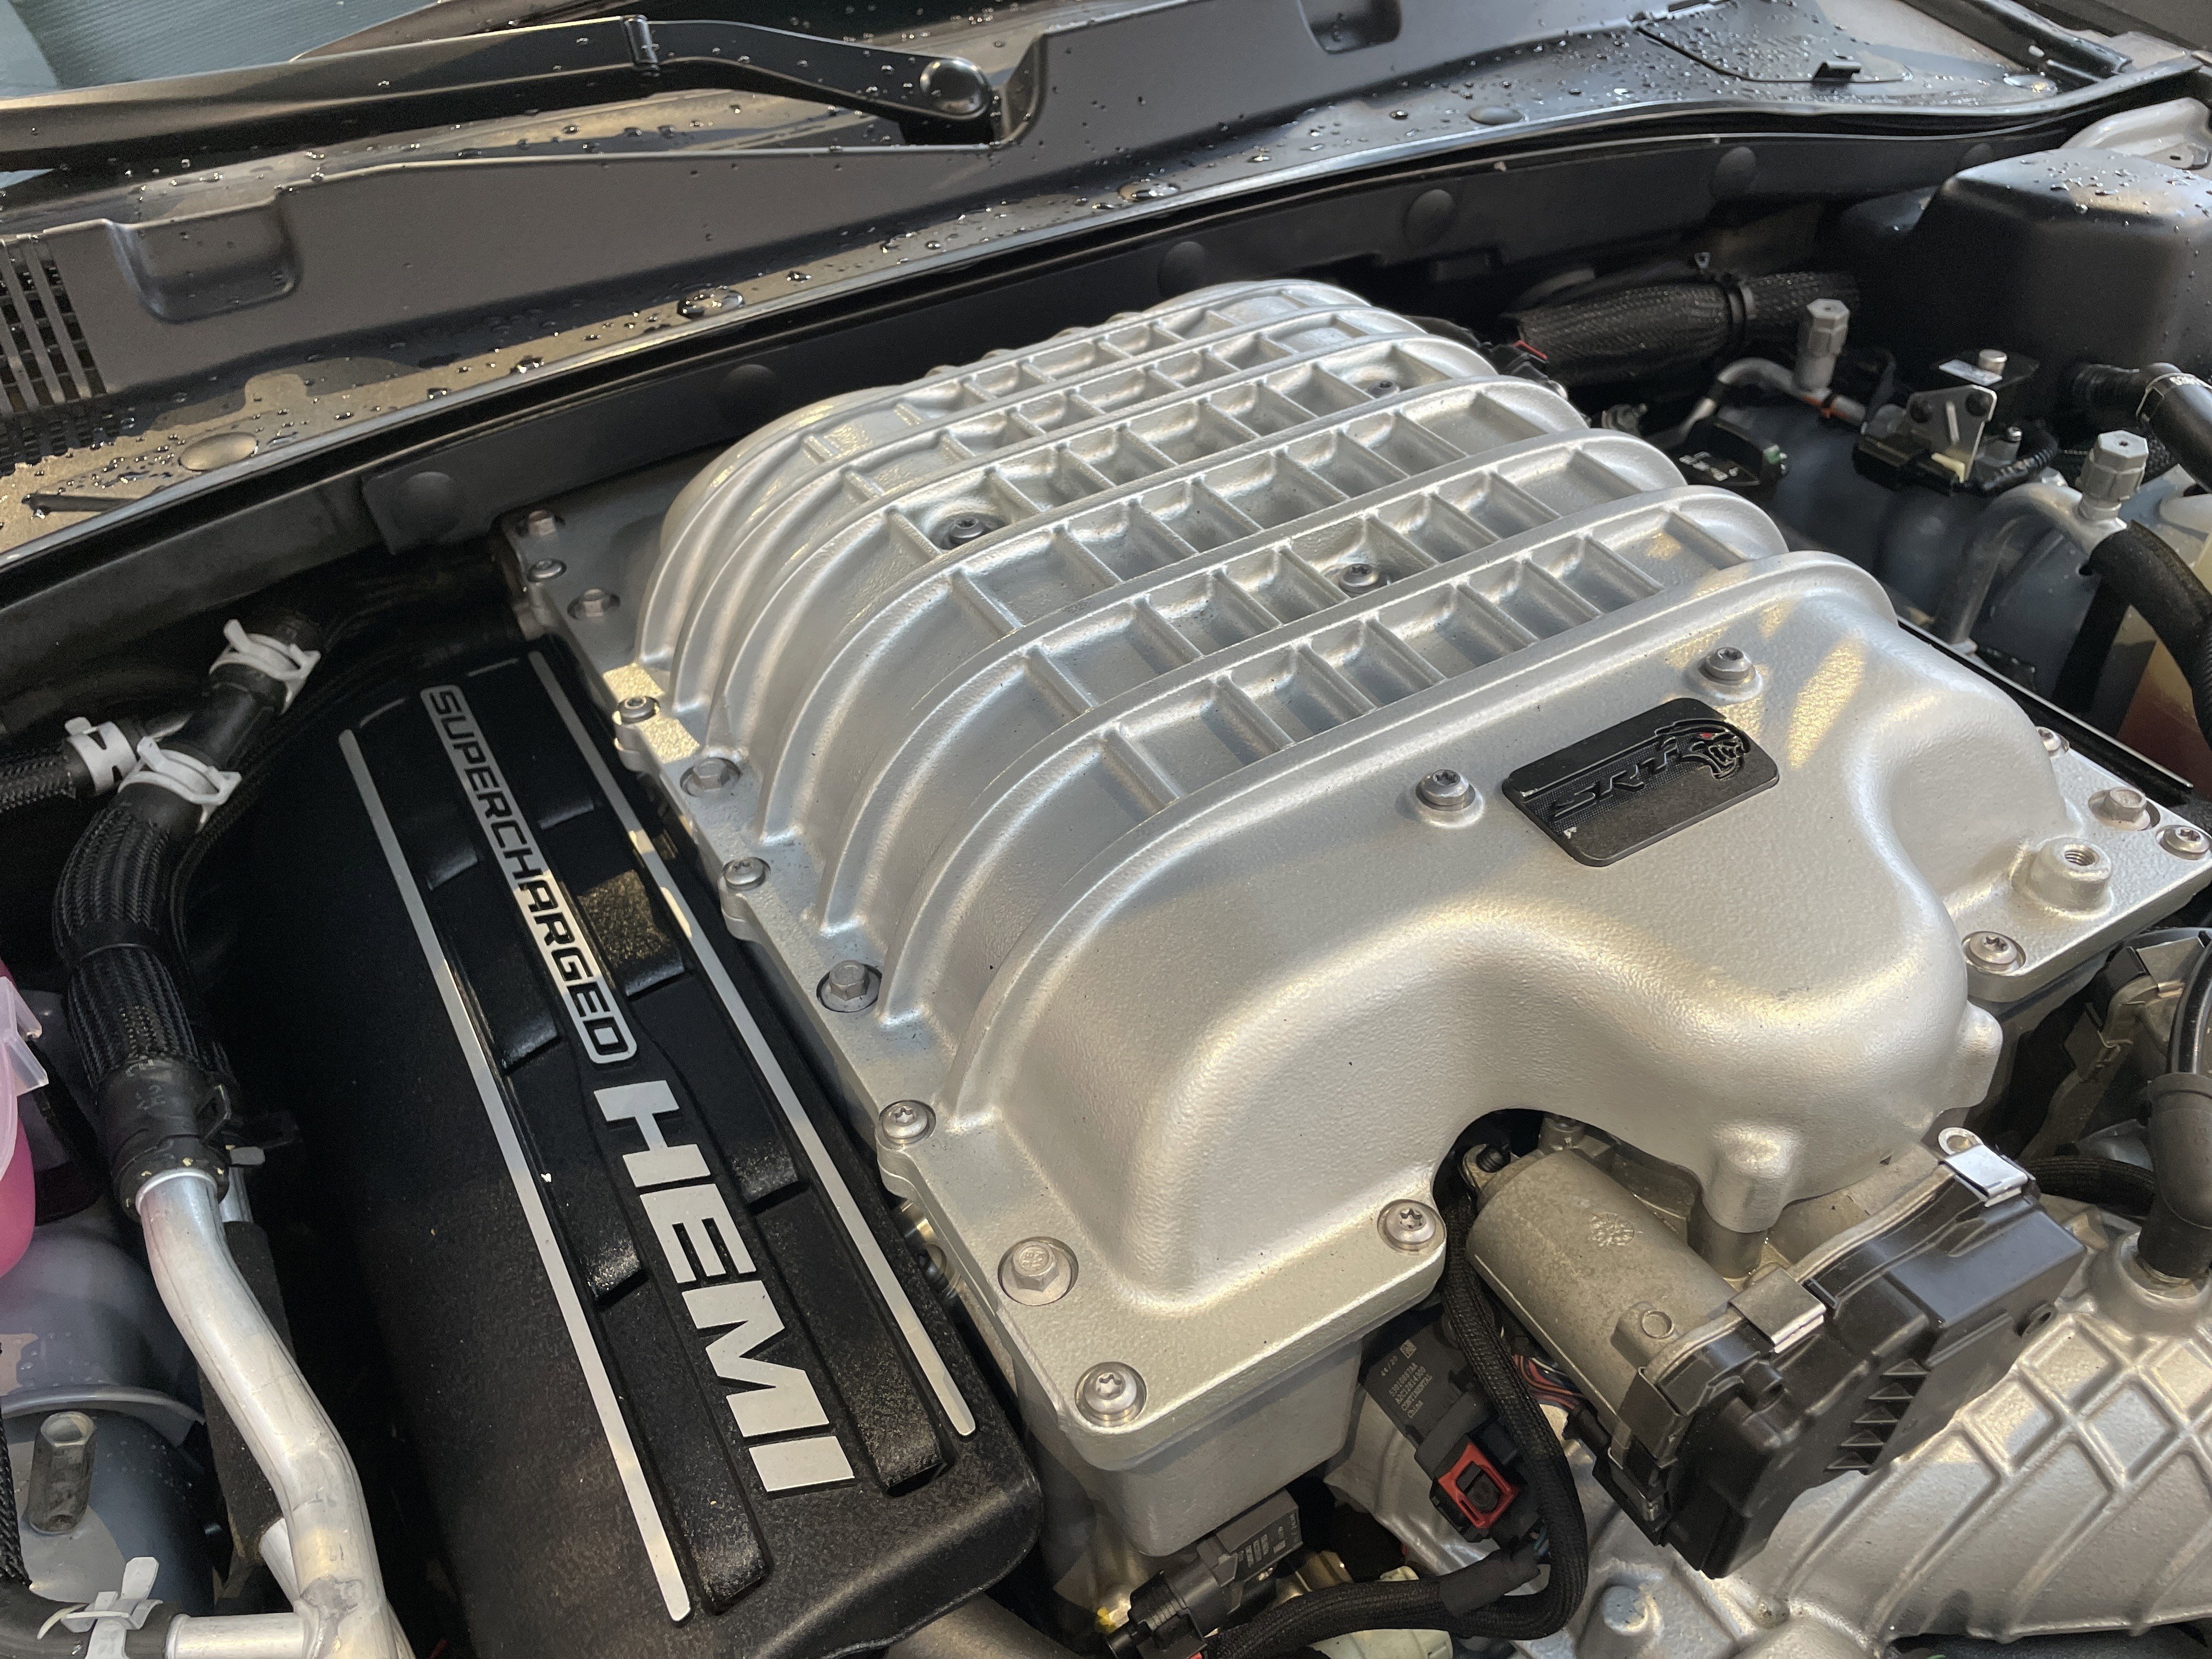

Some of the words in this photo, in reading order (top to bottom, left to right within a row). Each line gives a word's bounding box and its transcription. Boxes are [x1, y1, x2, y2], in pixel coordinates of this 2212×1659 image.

[429, 690, 629, 1056] SUPERCHARGED
[1551, 736, 1680, 819] SRT
[594, 1080, 855, 1492] HEMI
